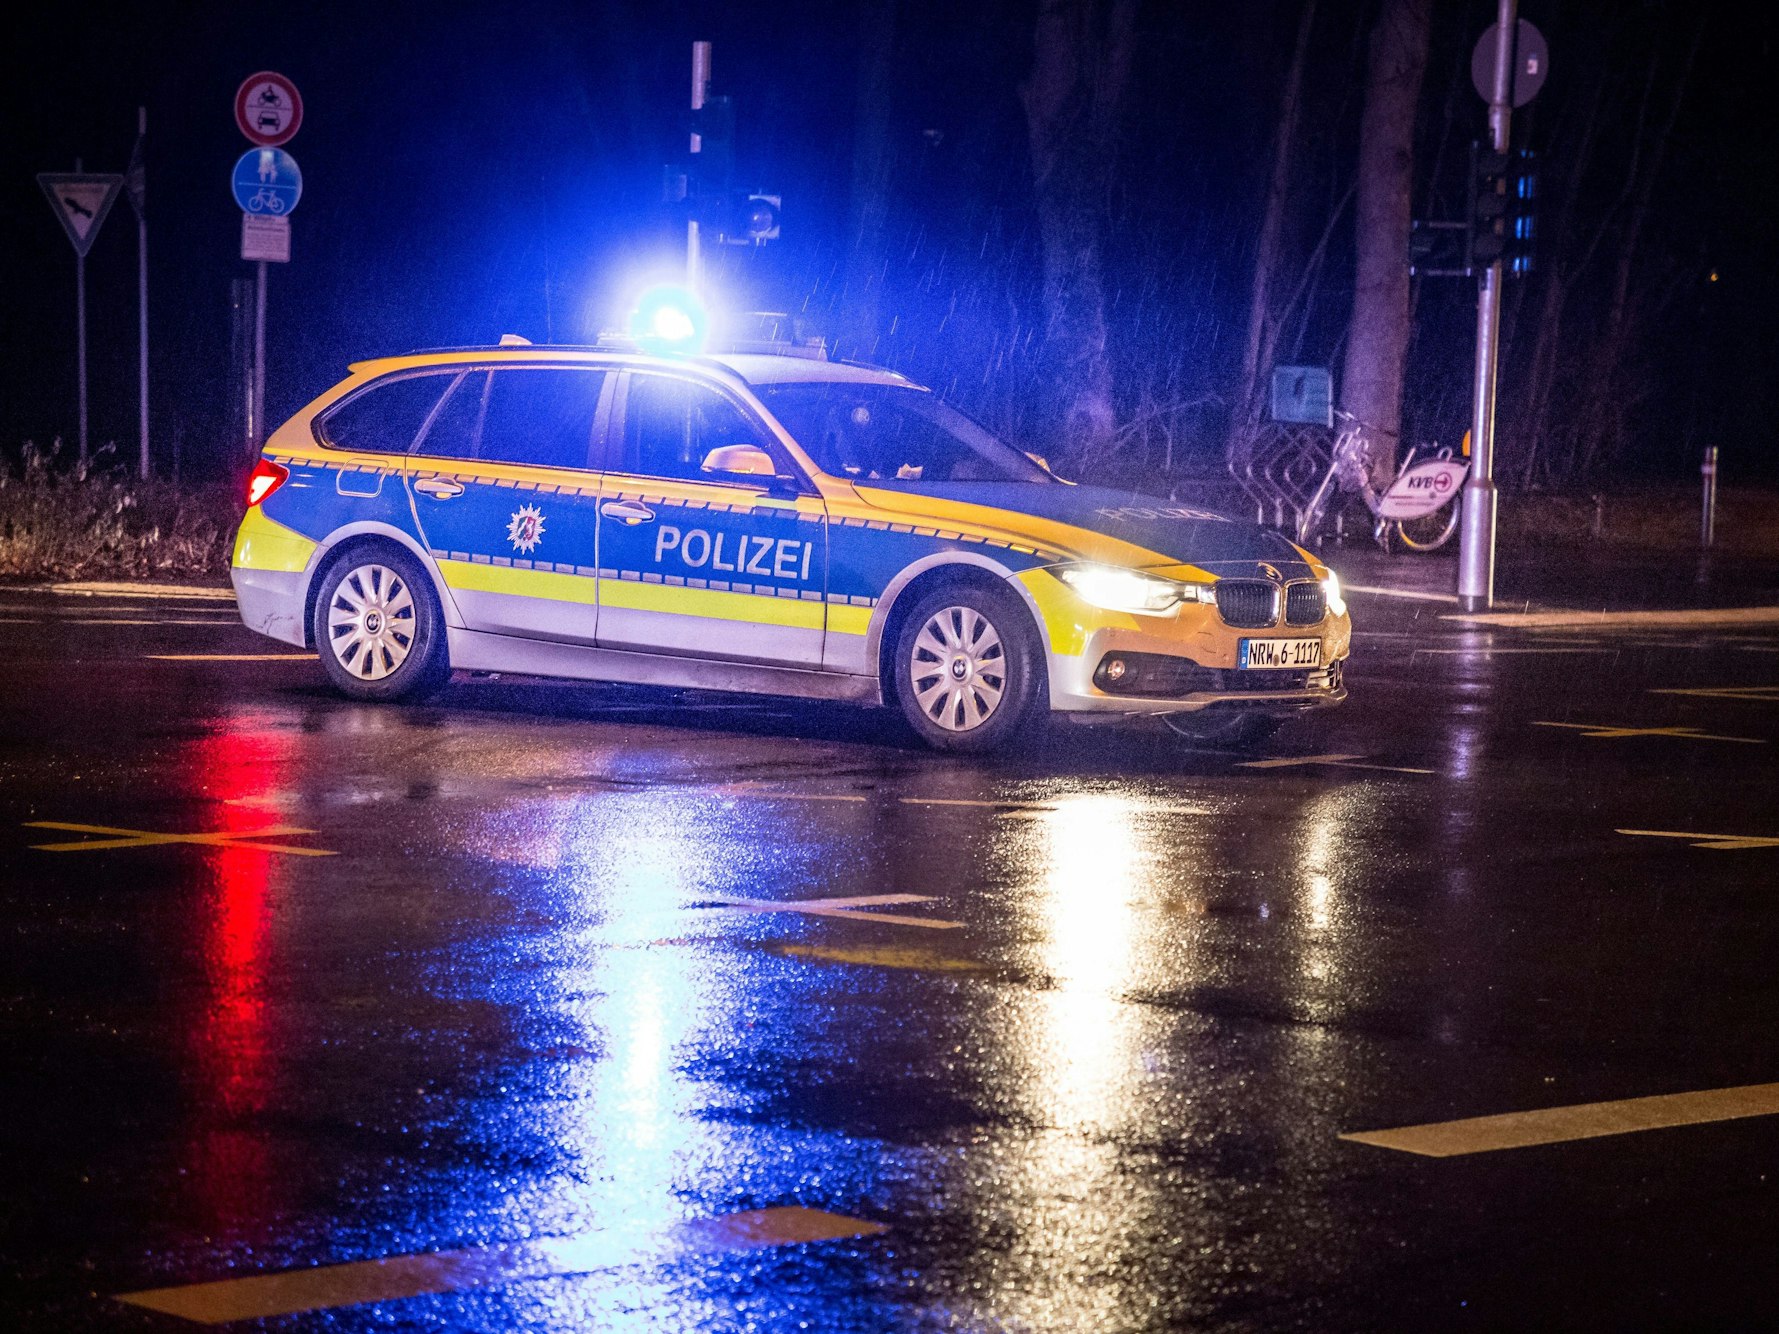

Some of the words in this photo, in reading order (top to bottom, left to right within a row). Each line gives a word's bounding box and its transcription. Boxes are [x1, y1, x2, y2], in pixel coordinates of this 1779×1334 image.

[1408, 476, 1434, 489] KVB
[655, 525, 812, 580] POLIZEI
[1248, 642, 1274, 665] NRW
[1281, 641, 1320, 665] 6-1117
